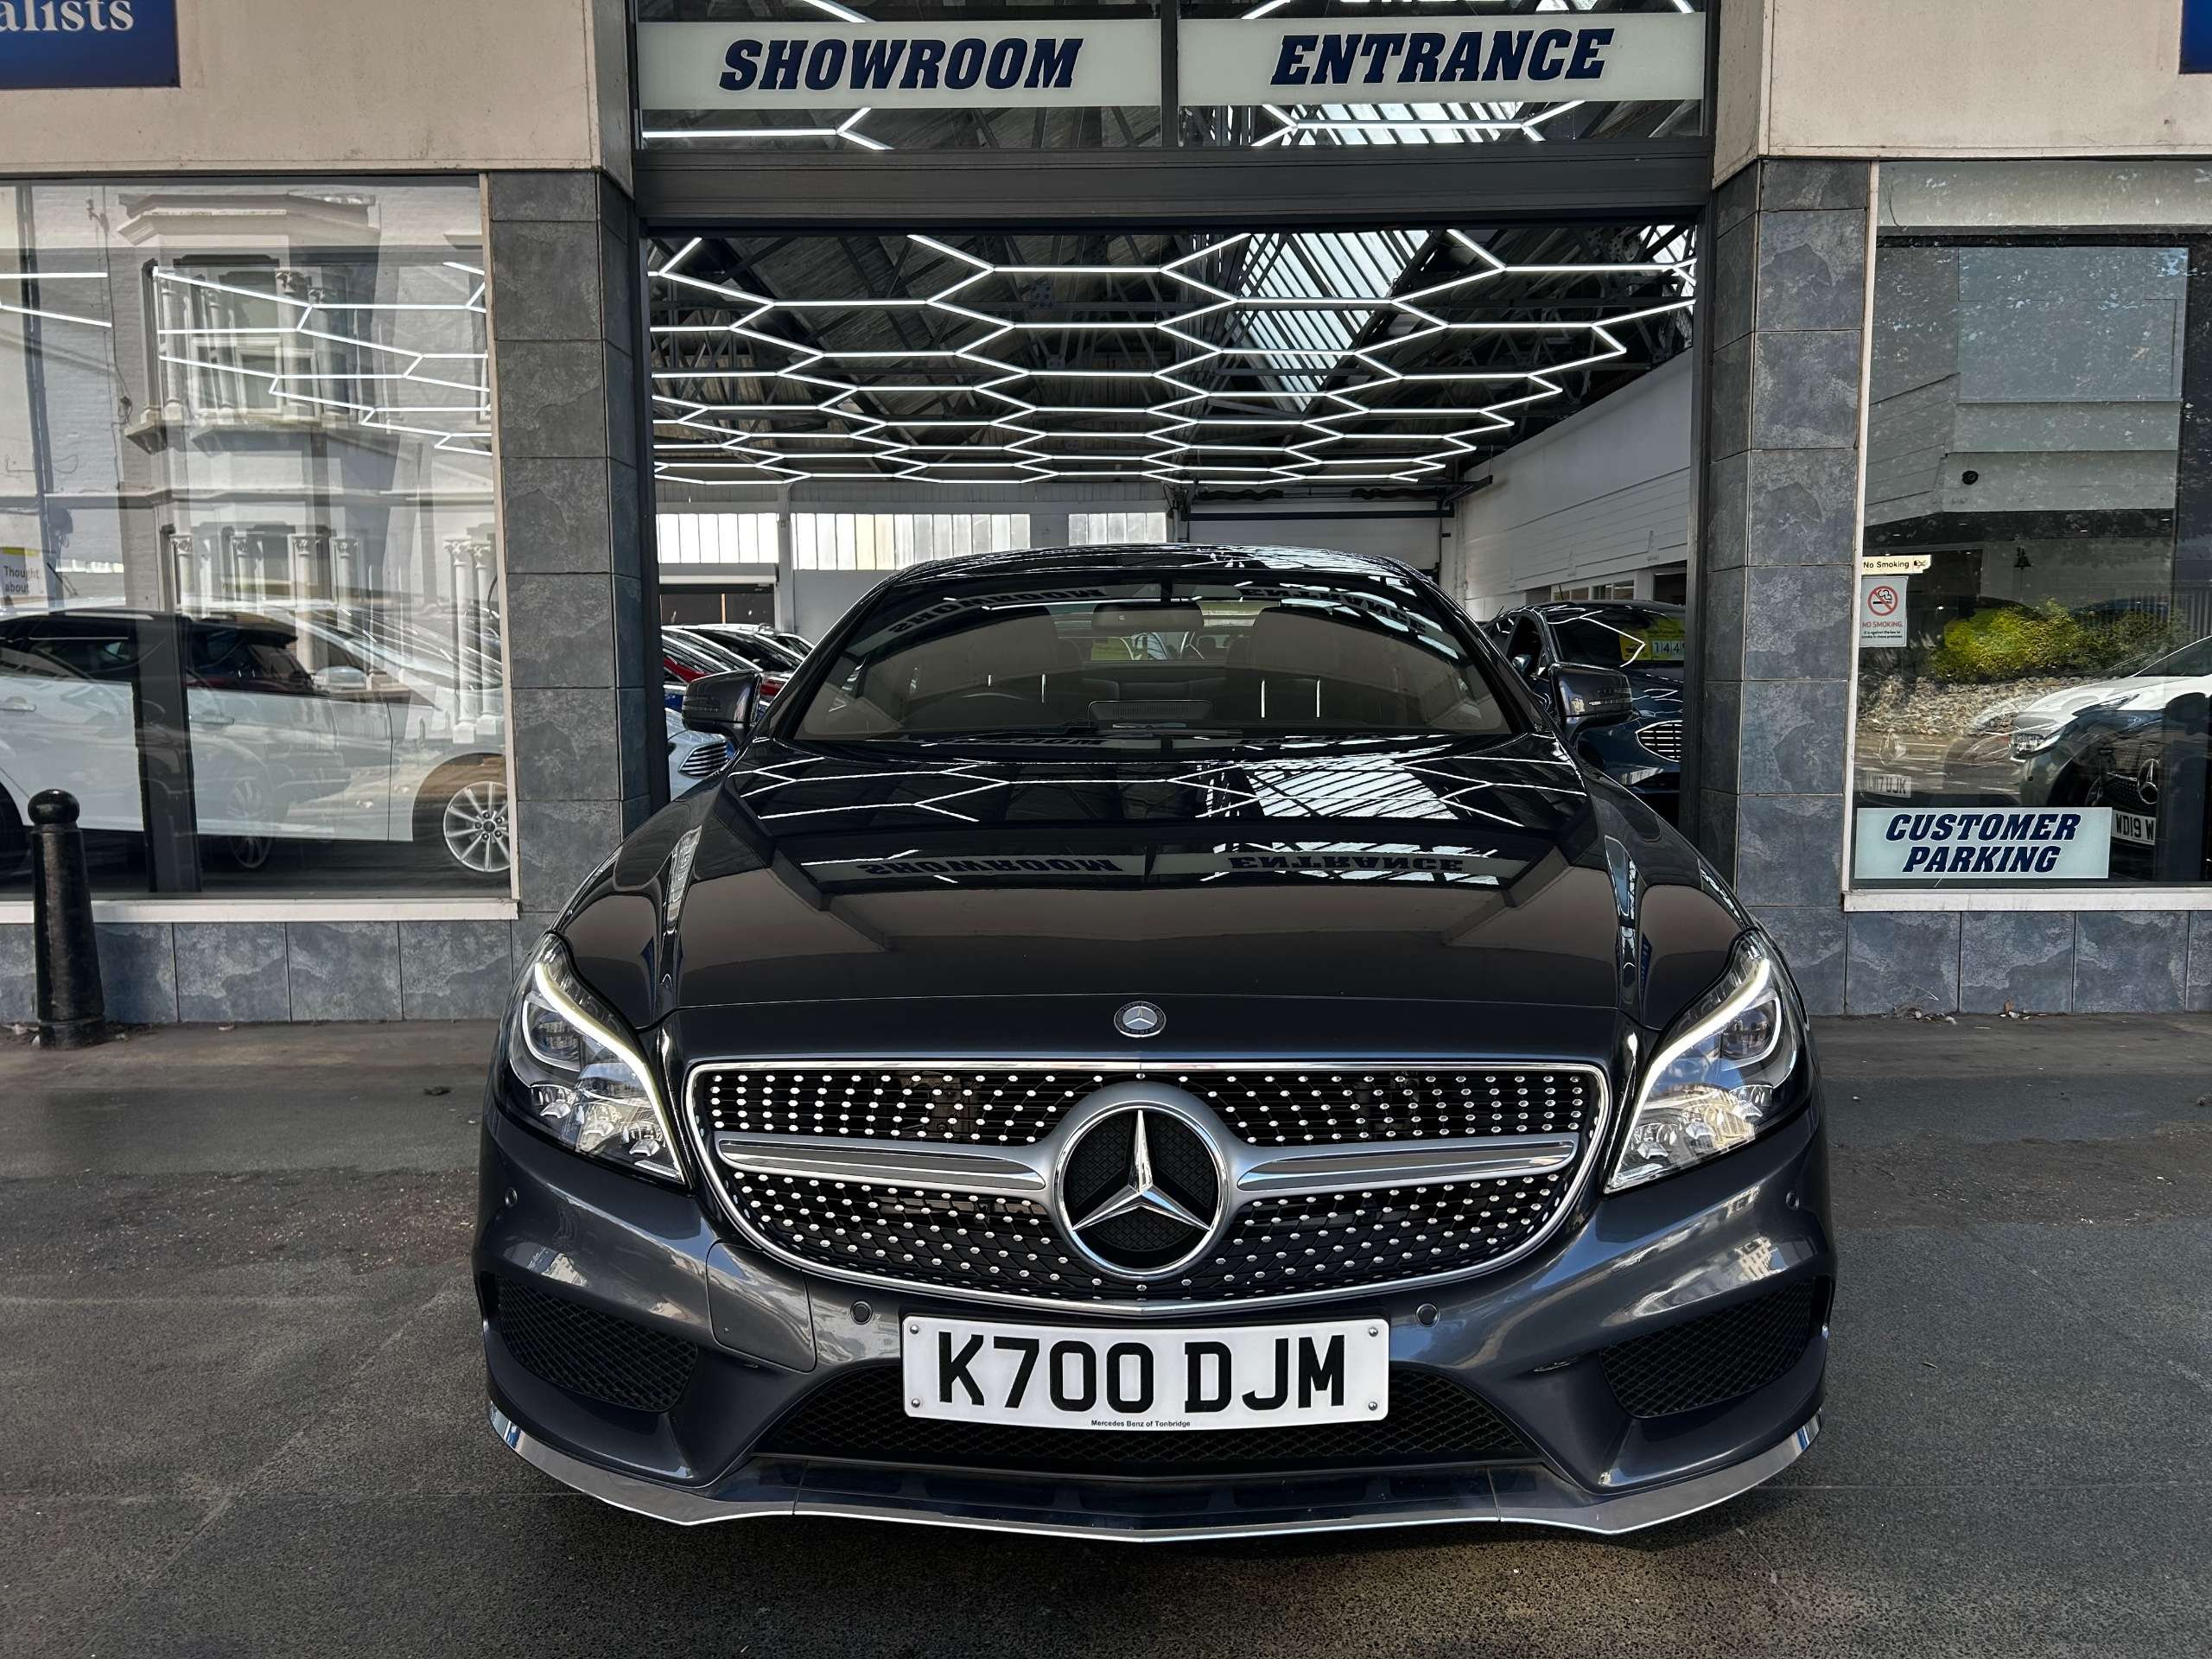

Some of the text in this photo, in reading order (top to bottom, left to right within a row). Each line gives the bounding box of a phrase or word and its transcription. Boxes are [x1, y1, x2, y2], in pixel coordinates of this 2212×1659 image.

[719, 38, 1084, 91] SHOWROOM
[1270, 28, 1615, 86] ENTRANCE
[3, 565, 41, 581] Thought
[1876, 561, 1910, 569] Smoking
[1885, 813, 2082, 841] CUSTOMER
[2115, 813, 2142, 838] WD19
[1902, 845, 2062, 873] PARKING
[938, 1332, 1345, 1414] K700 DJM
